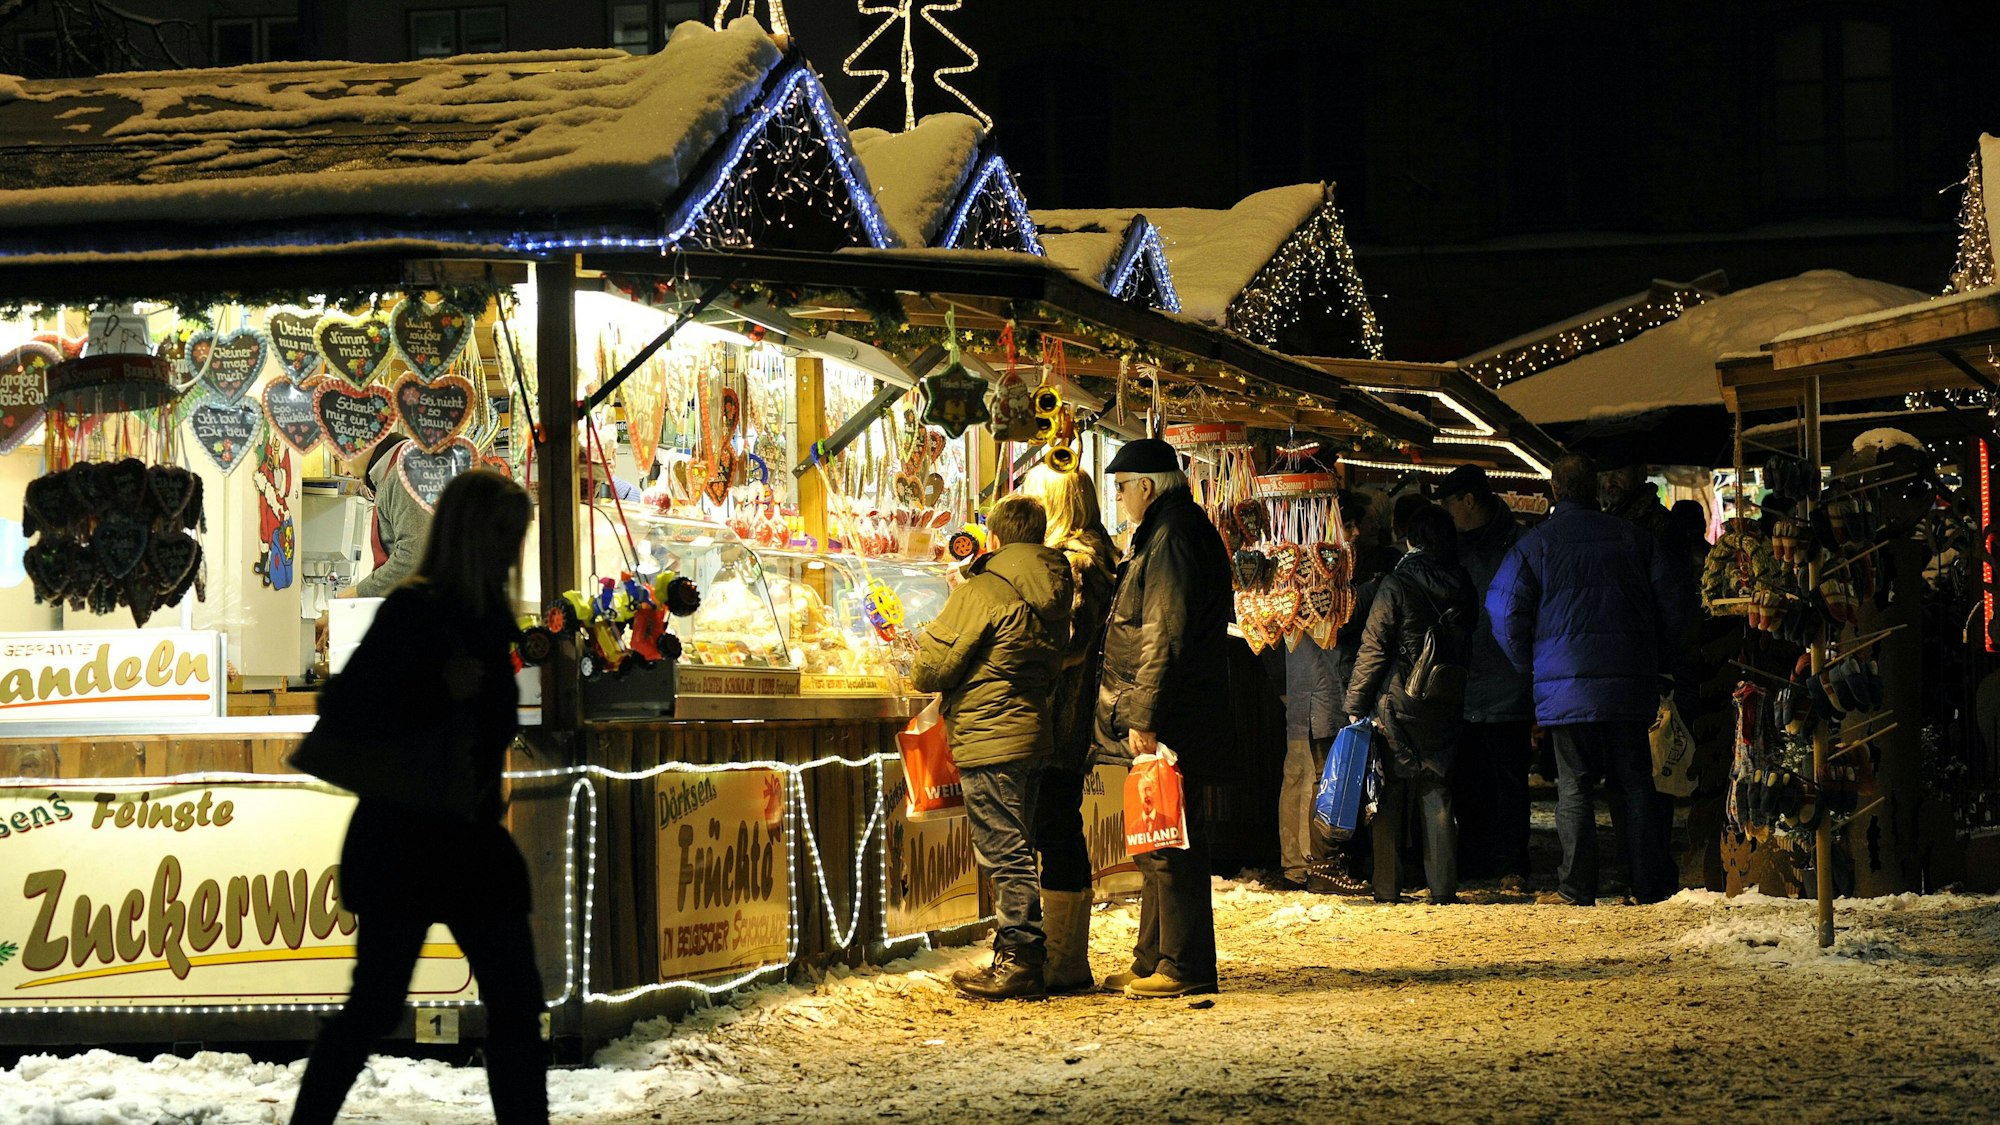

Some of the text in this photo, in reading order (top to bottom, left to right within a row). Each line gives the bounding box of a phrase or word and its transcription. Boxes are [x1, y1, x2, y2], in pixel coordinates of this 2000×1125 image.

[277, 320, 314, 337] Vertra
[329, 331, 368, 345] Nimm
[213, 345, 252, 358] Keiner
[300, 340, 317, 352] mi
[339, 345, 372, 358] mich
[223, 360, 249, 373] mag
[216, 369, 244, 381] mich
[336, 396, 376, 415] Schenk
[419, 394, 464, 409] Sei nicht
[198, 412, 241, 425] Ich bin
[326, 409, 369, 427] mir ein
[427, 408, 441, 417] so
[198, 425, 249, 437] Dir treu
[331, 421, 374, 439] Lächeln
[418, 415, 454, 433] traurig
[1190, 431, 1221, 442] SCHMIDT
[408, 455, 434, 469] Freu
[422, 469, 447, 482] auf
[1278, 480, 1306, 491] SCHMIDT
[924, 783, 963, 800] WEIL
[92, 791, 235, 831] Feinste
[1126, 826, 1179, 846] WEILAND
[677, 817, 774, 912] Früchte
[21, 854, 357, 980] Zuckerwa
[663, 909, 788, 961] IN BELGISCHER SCHOKOLADE
[429, 1013, 443, 1036] 1
